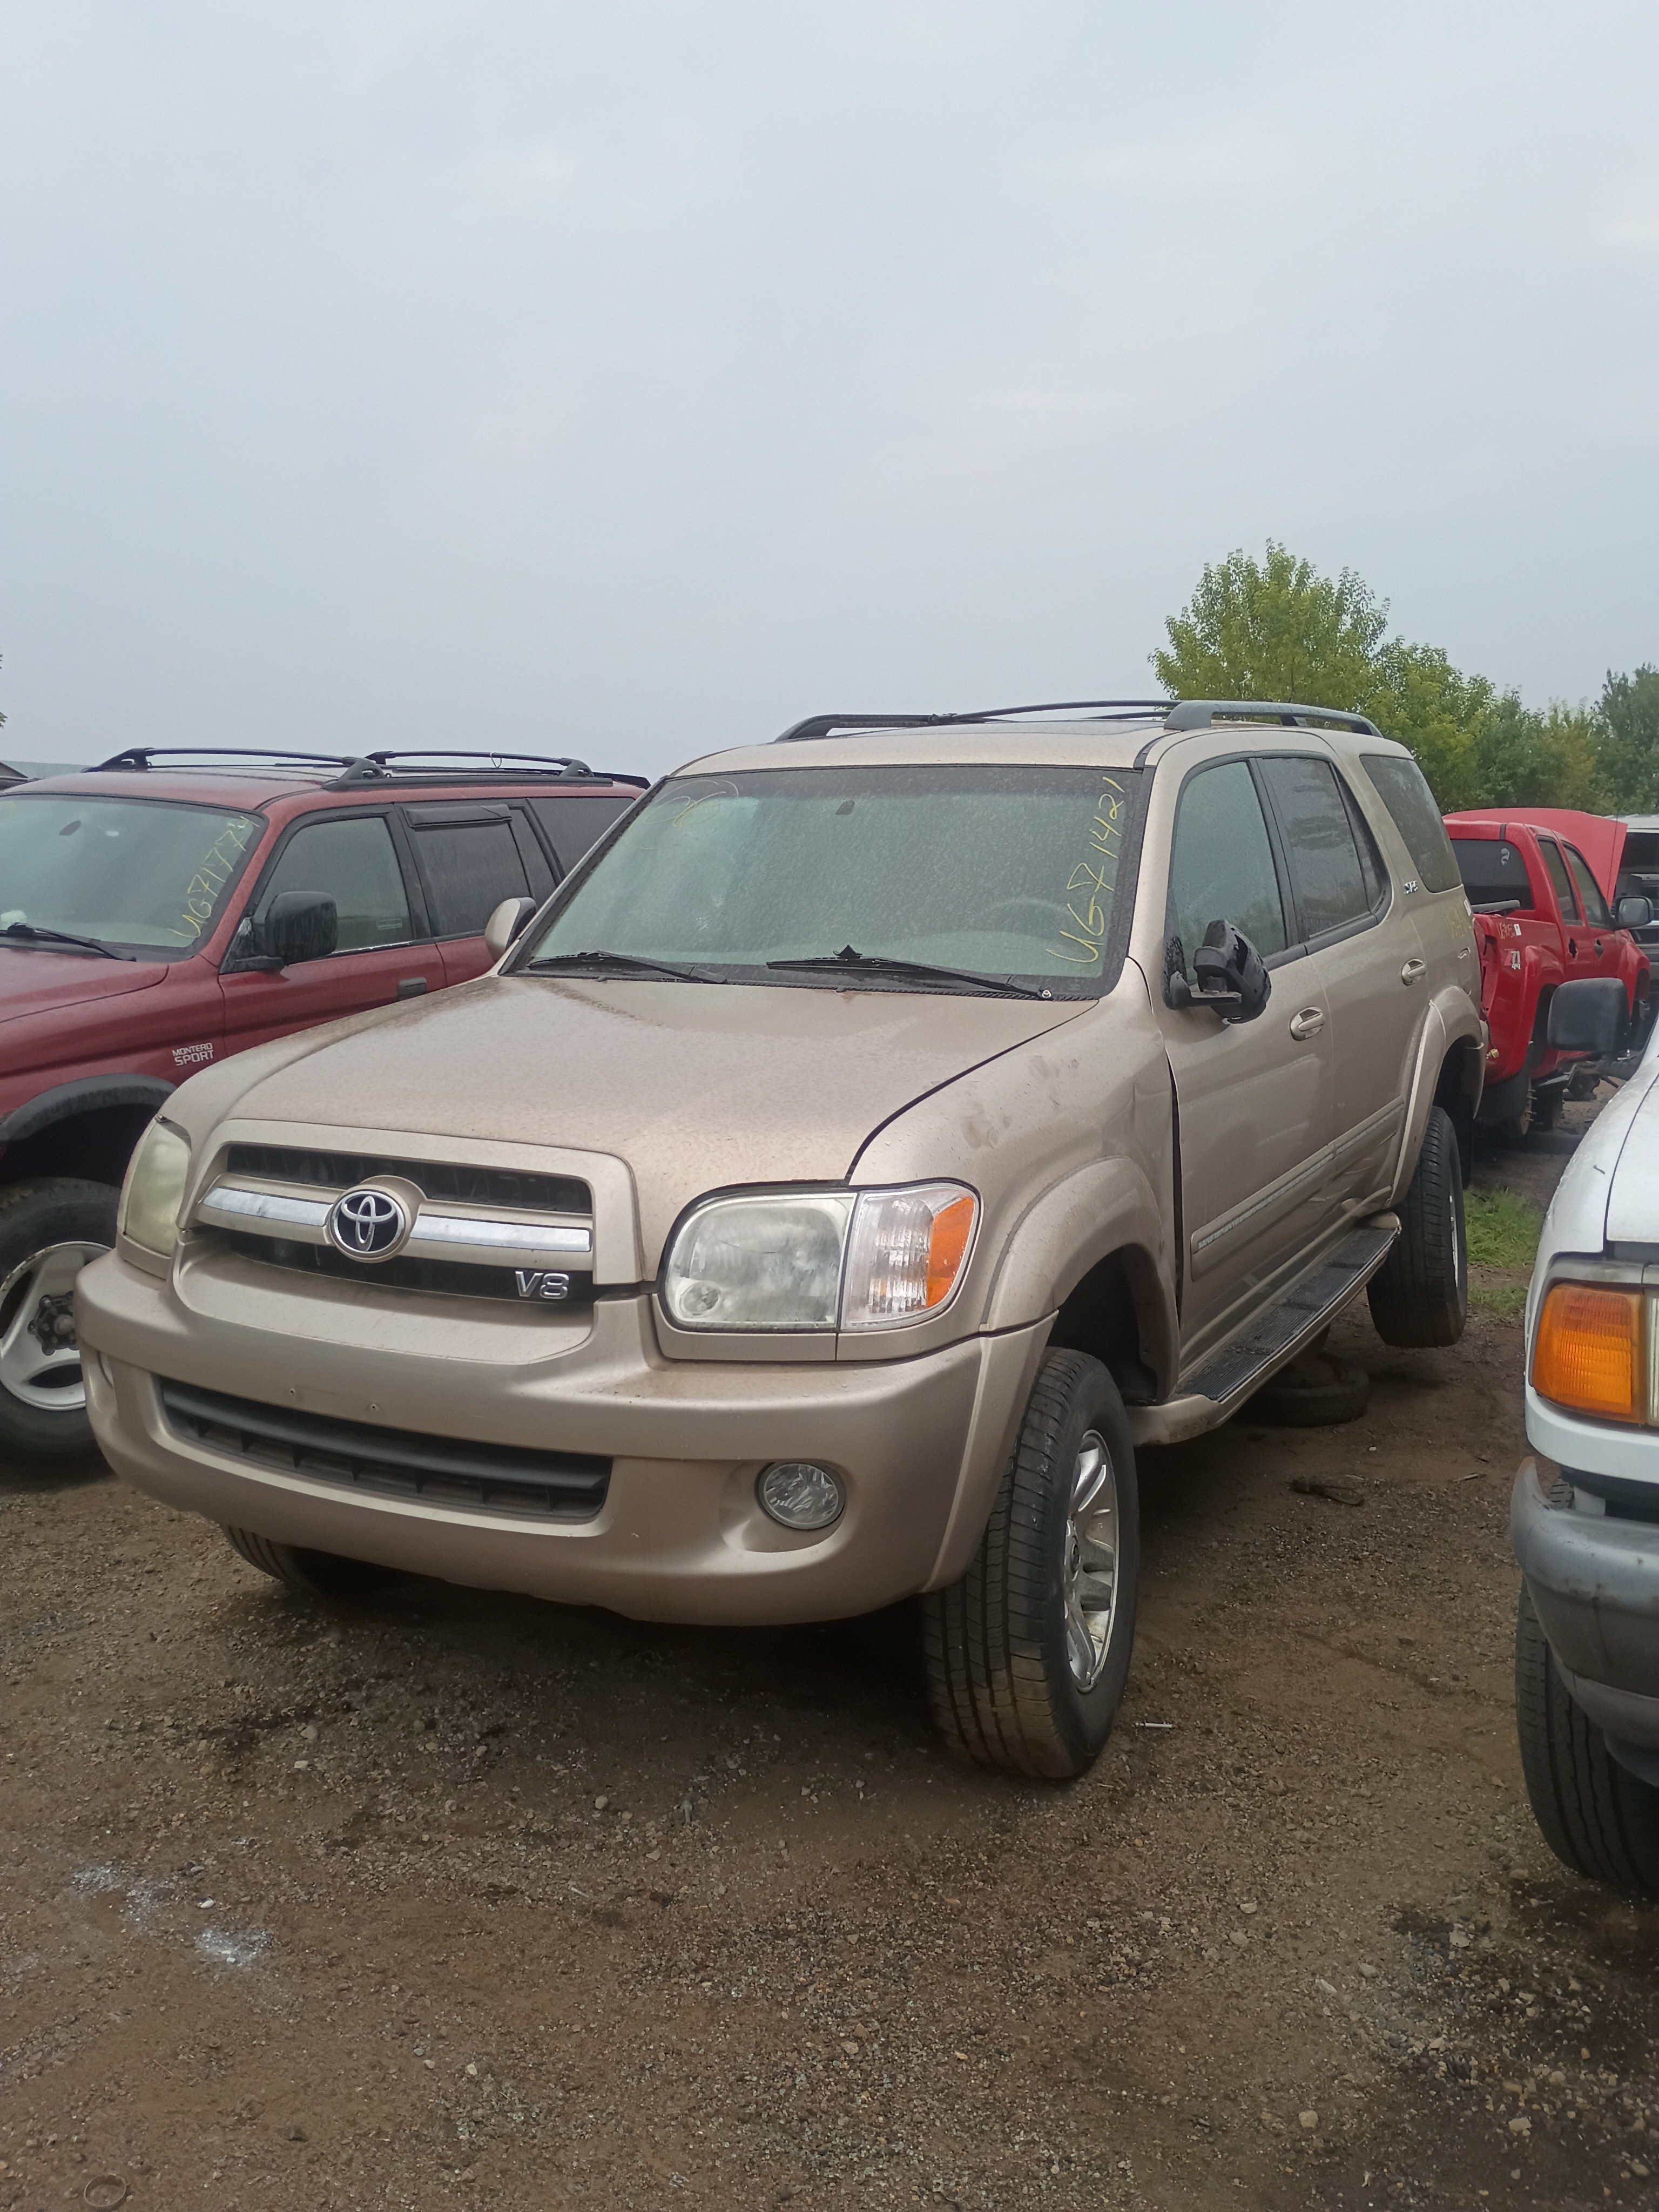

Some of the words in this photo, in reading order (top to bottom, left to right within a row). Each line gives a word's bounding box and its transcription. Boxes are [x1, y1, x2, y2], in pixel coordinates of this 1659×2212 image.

[172, 1042, 213, 1057] MONTERO
[174, 1049, 214, 1067] SPORT
[515, 1271, 570, 1300] V8
